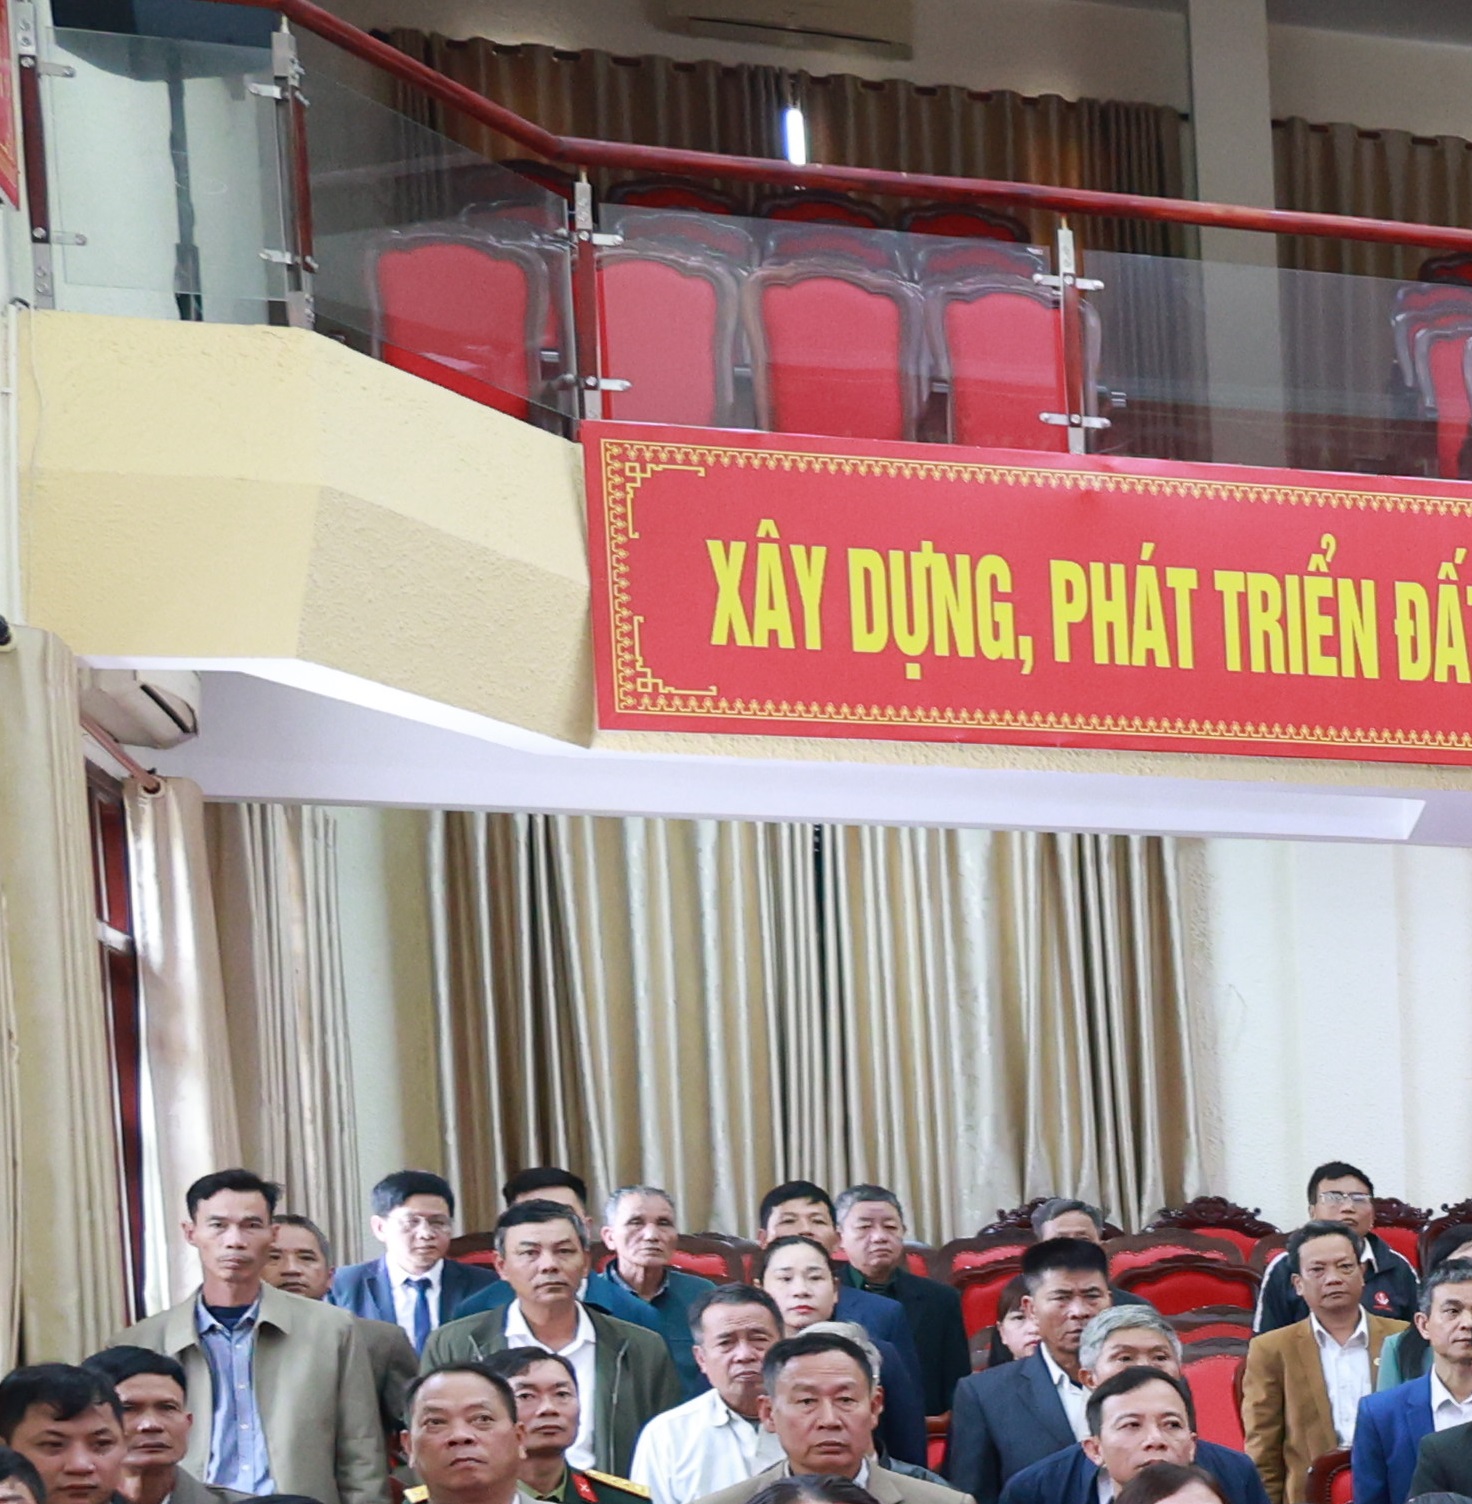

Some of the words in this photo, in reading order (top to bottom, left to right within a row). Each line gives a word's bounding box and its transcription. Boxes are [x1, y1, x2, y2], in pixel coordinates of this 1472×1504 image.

[709, 520, 826, 649] XÂY
[849, 541, 1033, 680] DỰNG,
[1052, 543, 1197, 669] PHÁT
[1216, 535, 1379, 678] TRIỂN
